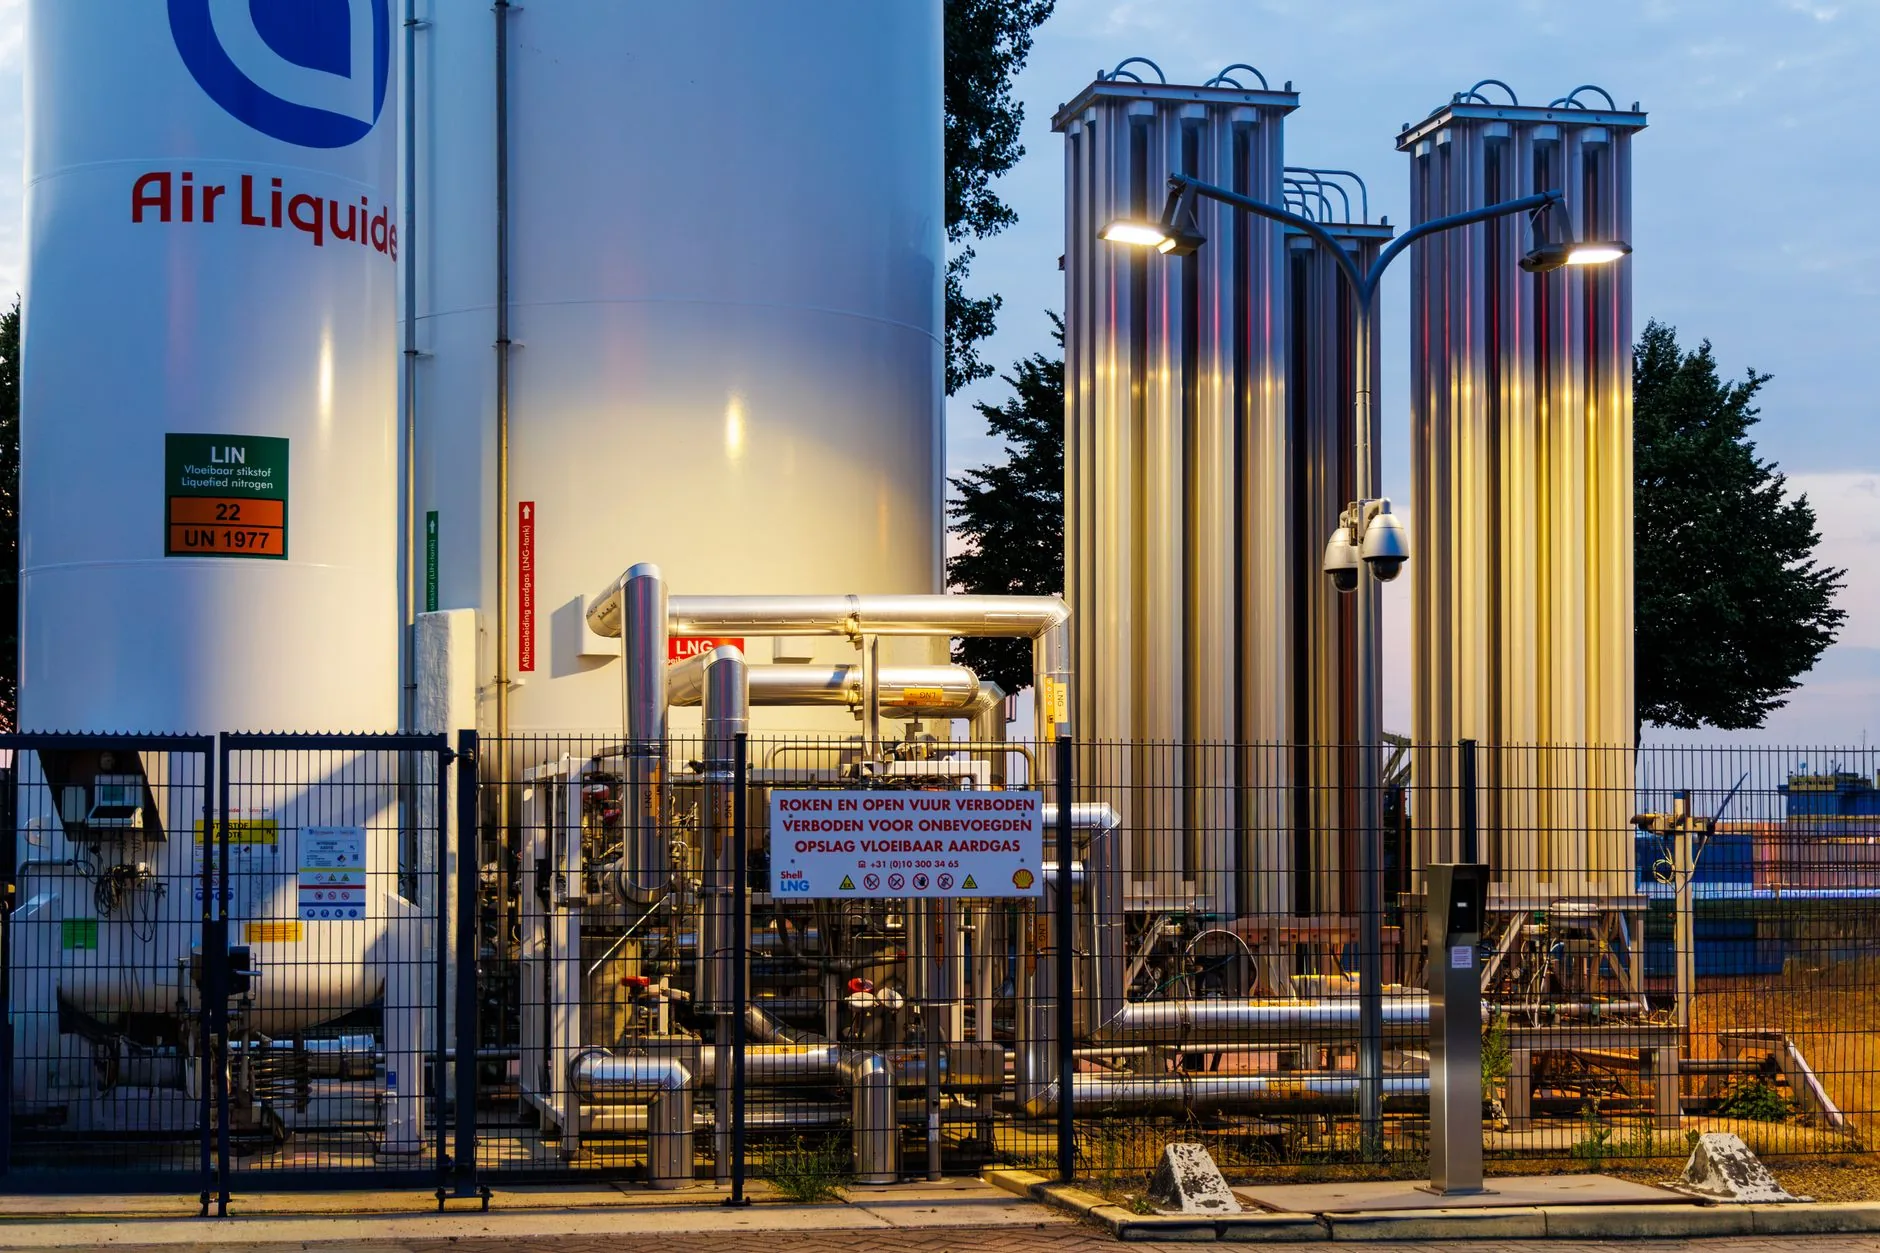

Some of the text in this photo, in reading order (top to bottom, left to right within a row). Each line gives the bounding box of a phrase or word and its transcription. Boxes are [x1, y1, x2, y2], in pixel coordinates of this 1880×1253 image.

[132, 171, 398, 262] Air Liquide
[211, 446, 245, 464] LIN
[184, 465, 272, 477] Vloeibaar stikstof
[181, 477, 273, 491] Liquefied nitrogen
[215, 503, 241, 521] 22
[184, 529, 270, 549] UN 1977
[522, 525, 531, 571] (LNG-tank)
[522, 573, 531, 607] aardgas
[676, 640, 713, 655] LNG
[779, 799, 1035, 811] ROKEN EN OPEN VUUR VERBODEN
[782, 819, 1032, 832] VERBODEN VOOR ONBEVOEGDEN
[795, 840, 1021, 853] OPSLAG VLOEIBAAR AARDGAS
[870, 859, 959, 869] +31 (0)10 300 34 65
[780, 871, 803, 880] Shell
[780, 880, 810, 892] LNG
